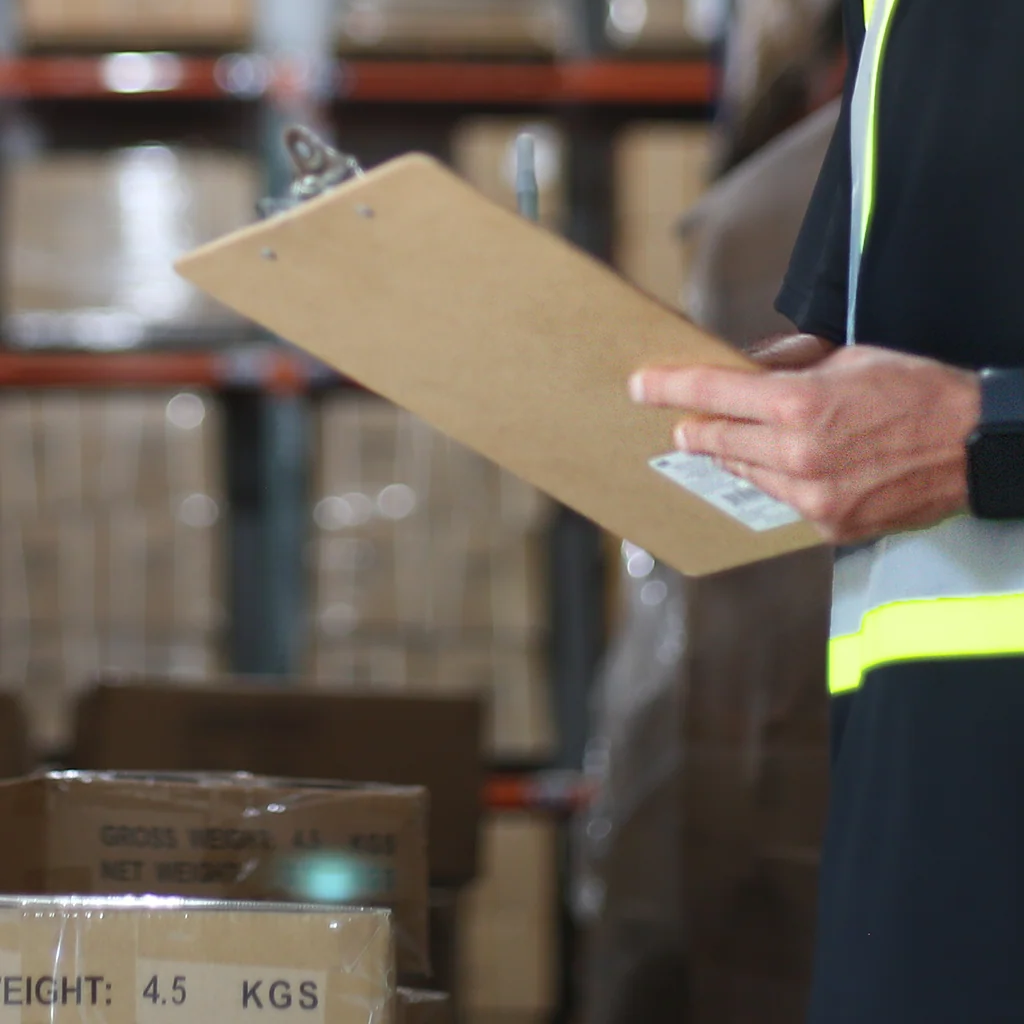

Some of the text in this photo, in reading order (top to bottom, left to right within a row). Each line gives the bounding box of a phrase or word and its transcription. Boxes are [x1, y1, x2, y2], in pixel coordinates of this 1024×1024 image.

[100, 824, 178, 850] GROSS
[100, 859, 145, 881] NET
[0, 974, 319, 1011] EIGHT: 4.5 KGS
